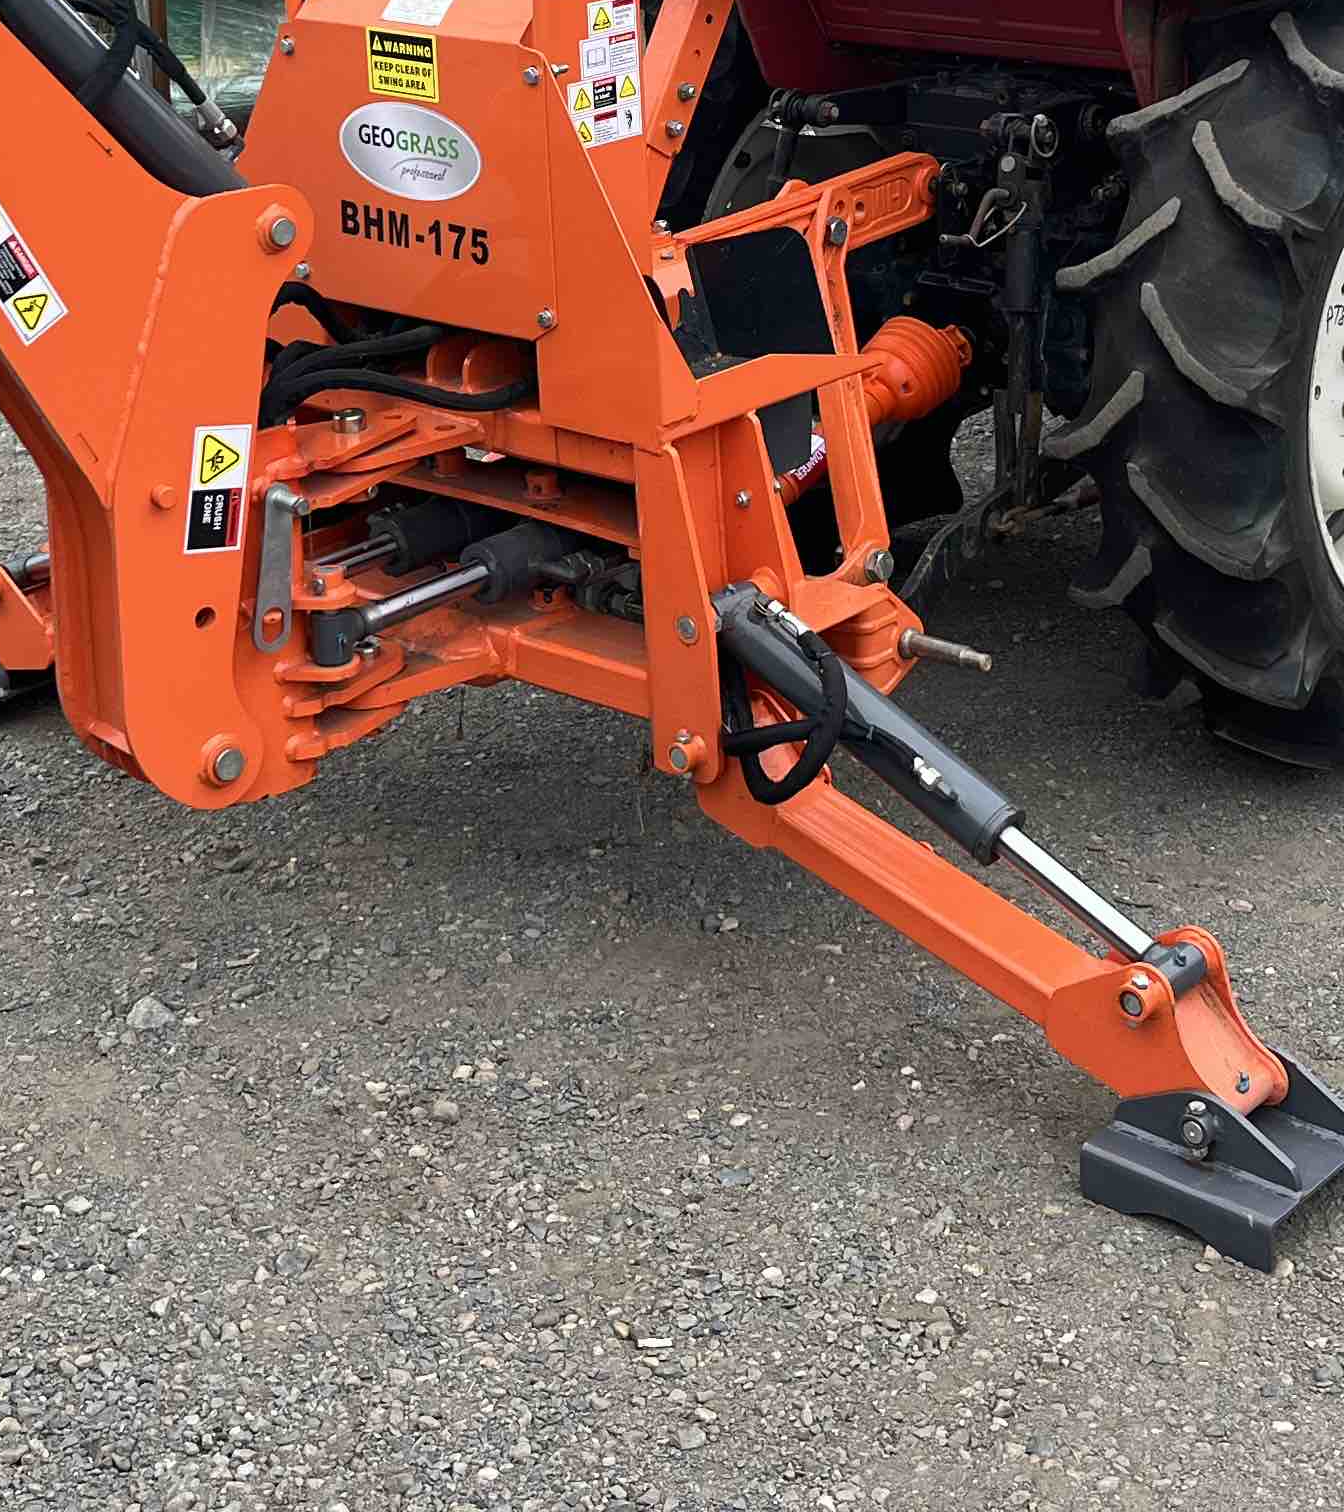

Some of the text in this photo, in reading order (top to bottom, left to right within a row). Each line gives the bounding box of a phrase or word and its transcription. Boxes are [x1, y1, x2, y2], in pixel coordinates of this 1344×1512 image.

[383, 40, 432, 58] WARNING
[374, 60, 433, 78] KEEP CLEAR OF
[378, 75, 427, 91] SWING AREA
[358, 123, 459, 160] GEOGRASS
[341, 199, 490, 266] BHM-175
[201, 494, 213, 524] ZONE
[212, 493, 225, 530] CRUSH
